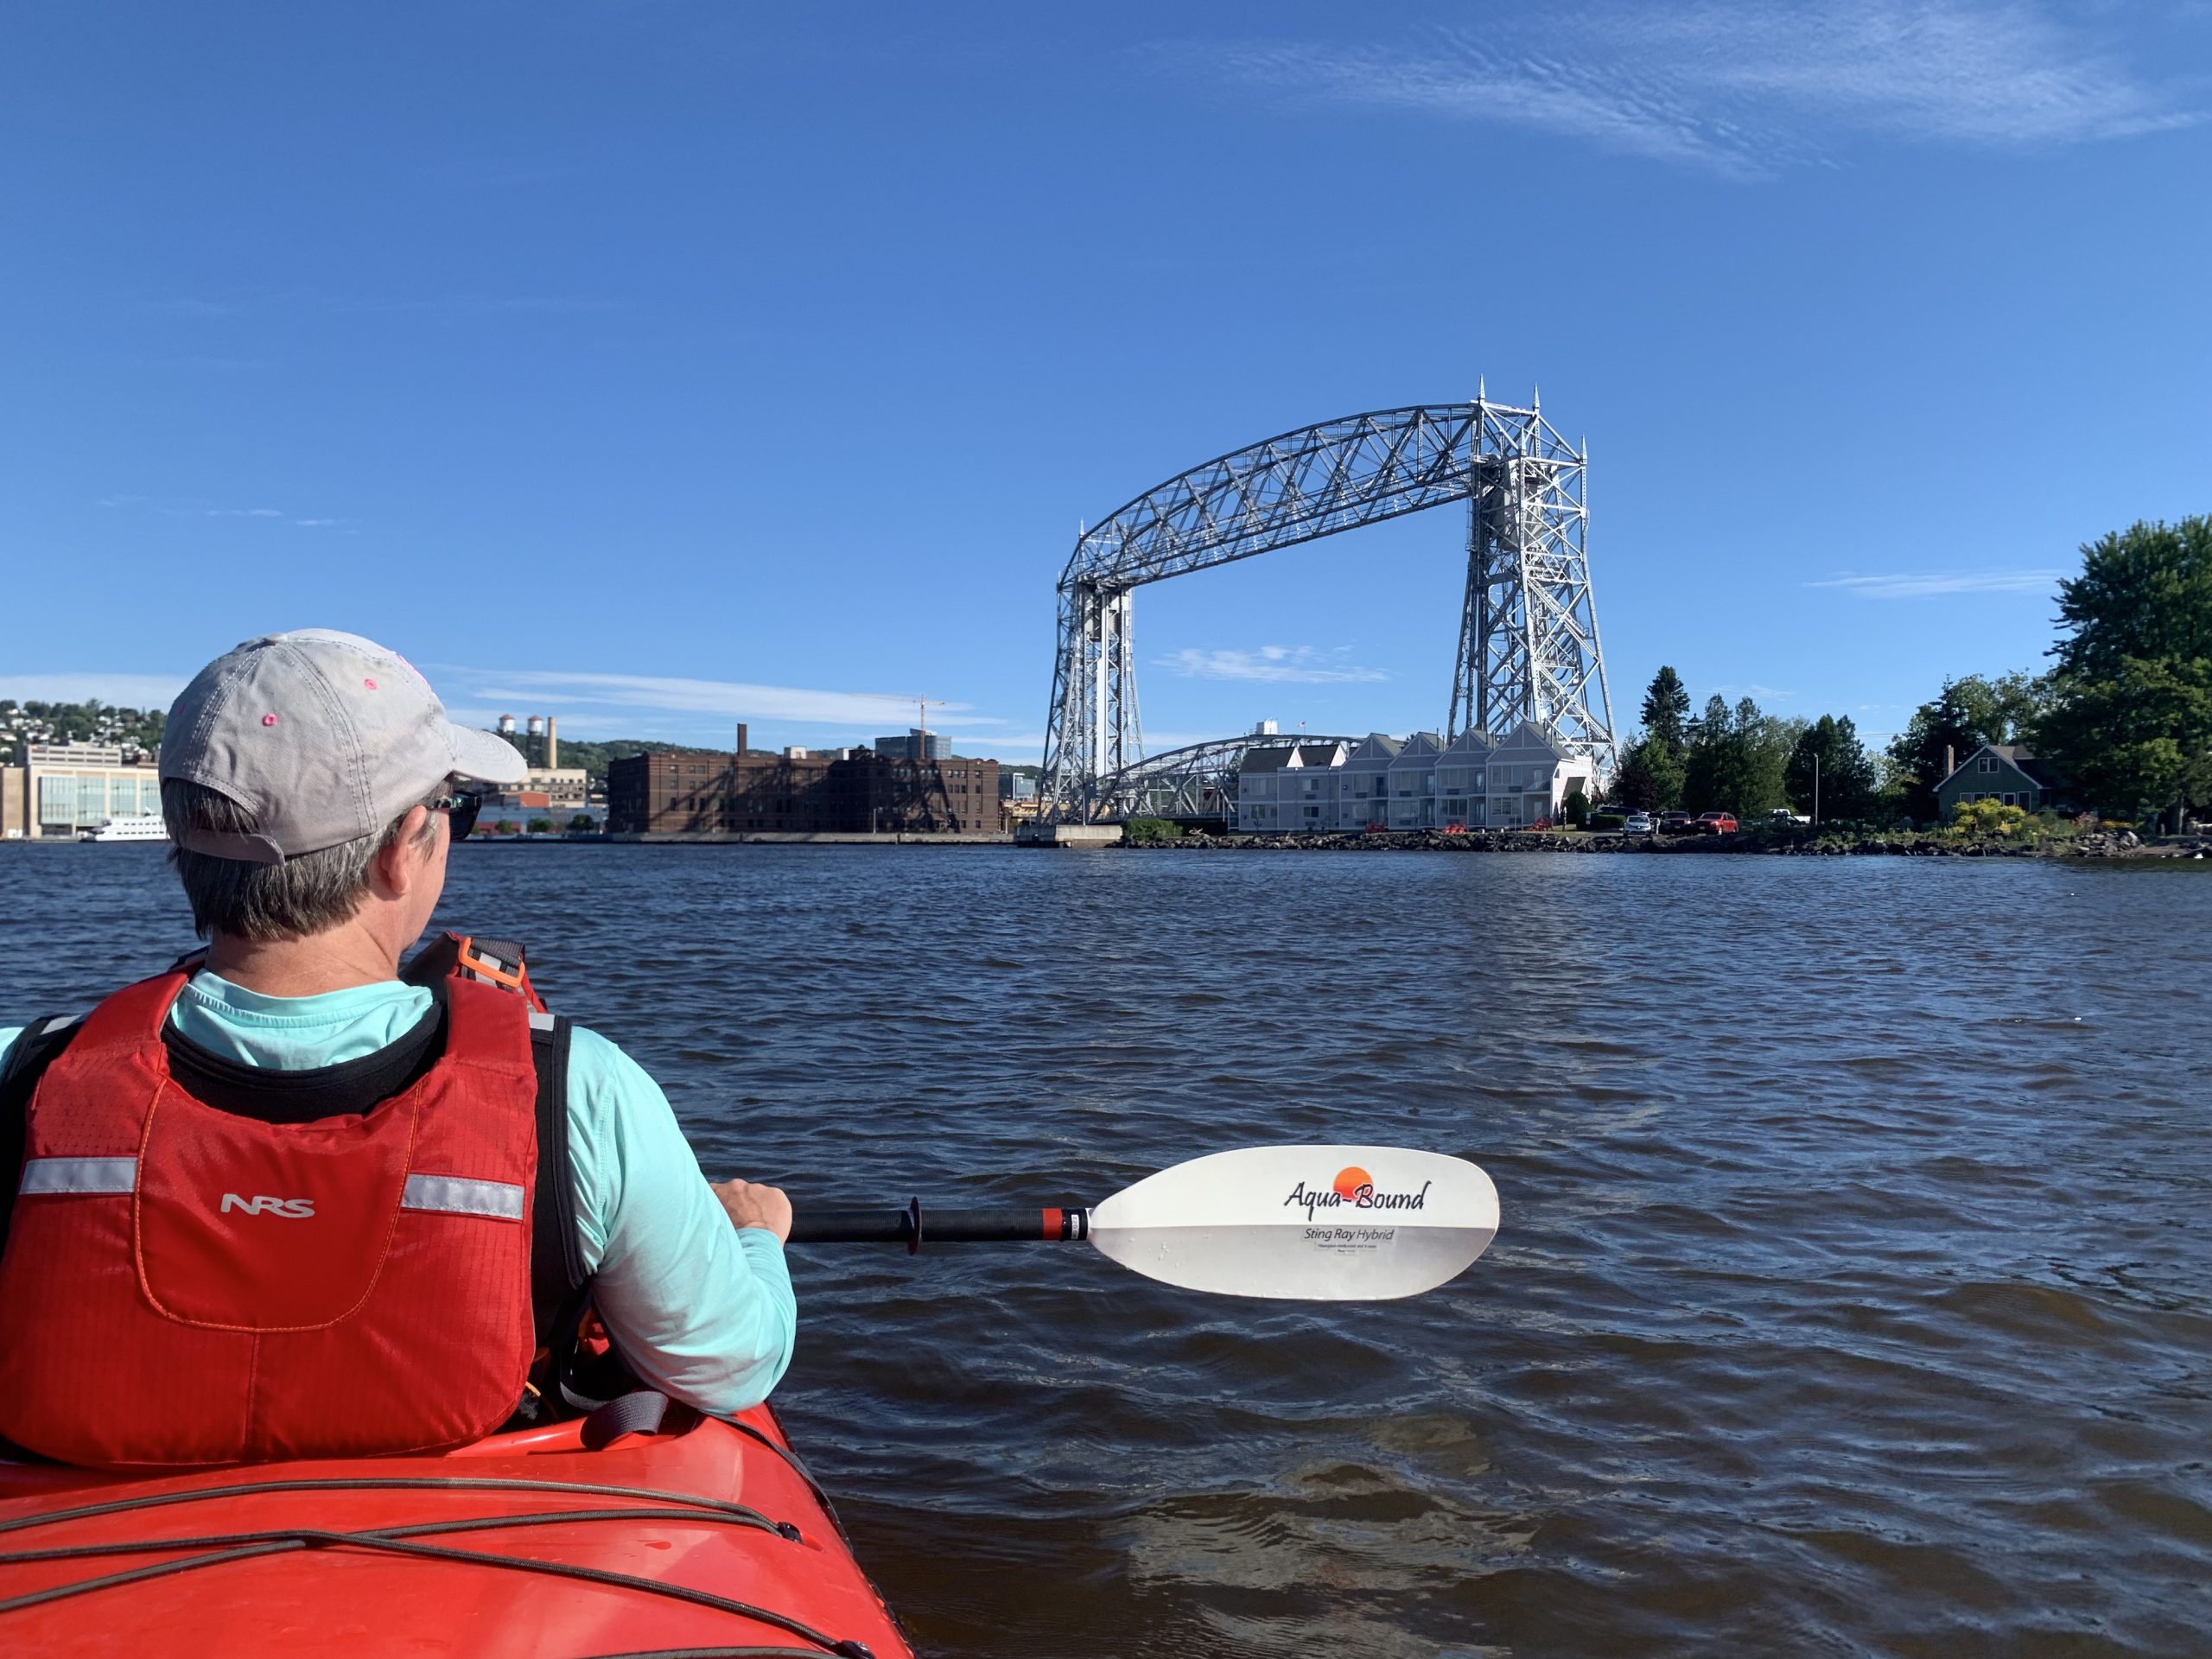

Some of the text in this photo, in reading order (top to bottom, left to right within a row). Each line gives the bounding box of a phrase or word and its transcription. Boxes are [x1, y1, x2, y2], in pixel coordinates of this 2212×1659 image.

[220, 1193, 315, 1218] NRS
[1284, 1180, 1432, 1222] Aqua-Bound
[1304, 1228, 1395, 1242] Sting Ray Hybrid
